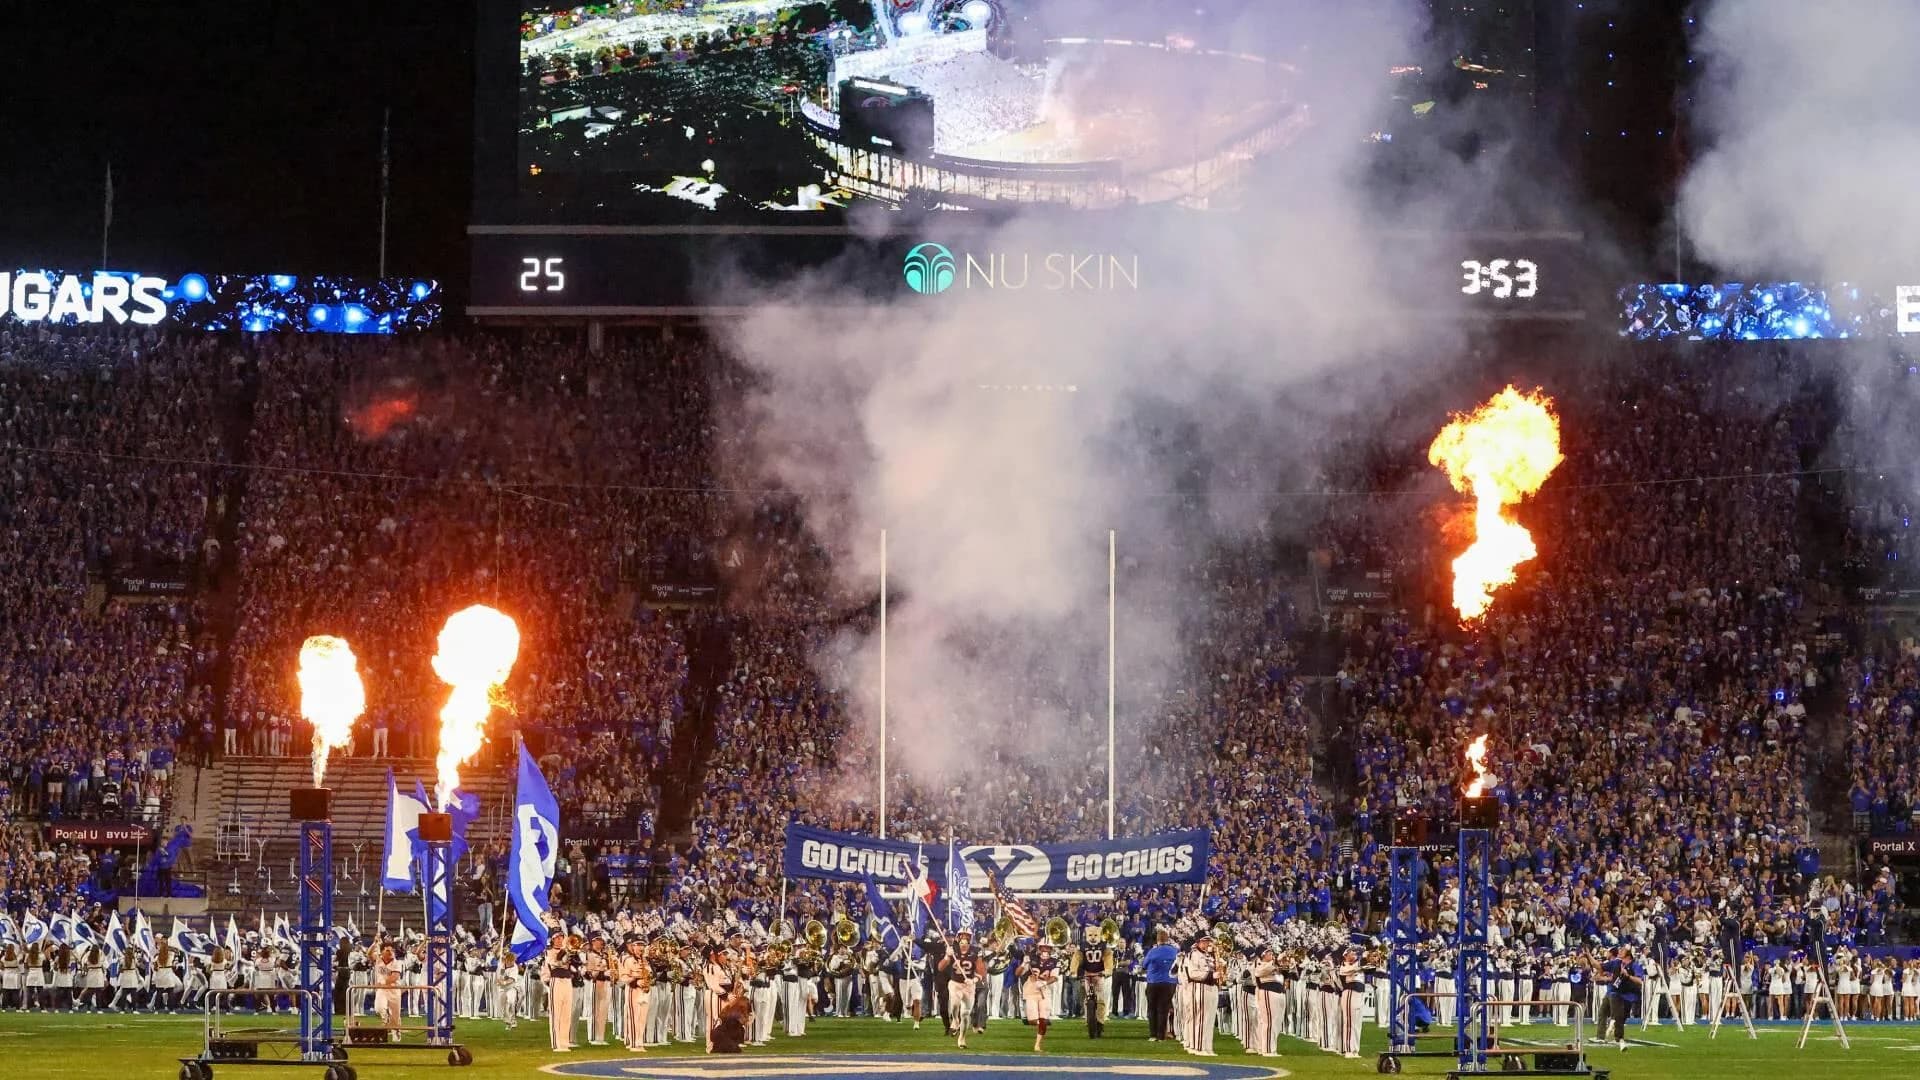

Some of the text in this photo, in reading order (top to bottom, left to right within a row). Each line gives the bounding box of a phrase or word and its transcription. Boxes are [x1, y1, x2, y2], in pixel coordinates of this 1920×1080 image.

[521, 257, 565, 291] 25
[966, 252, 1138, 290] NU SKIN
[1461, 258, 1538, 299] 3:53
[0, 271, 167, 324] GARS
[90, 830, 98, 840] U
[106, 831, 129, 839] BYU
[1872, 841, 1916, 852] Portal X
[802, 839, 839, 872] GO
[1066, 844, 1194, 882] GO COUGS
[1085, 950, 1102, 963] 00
